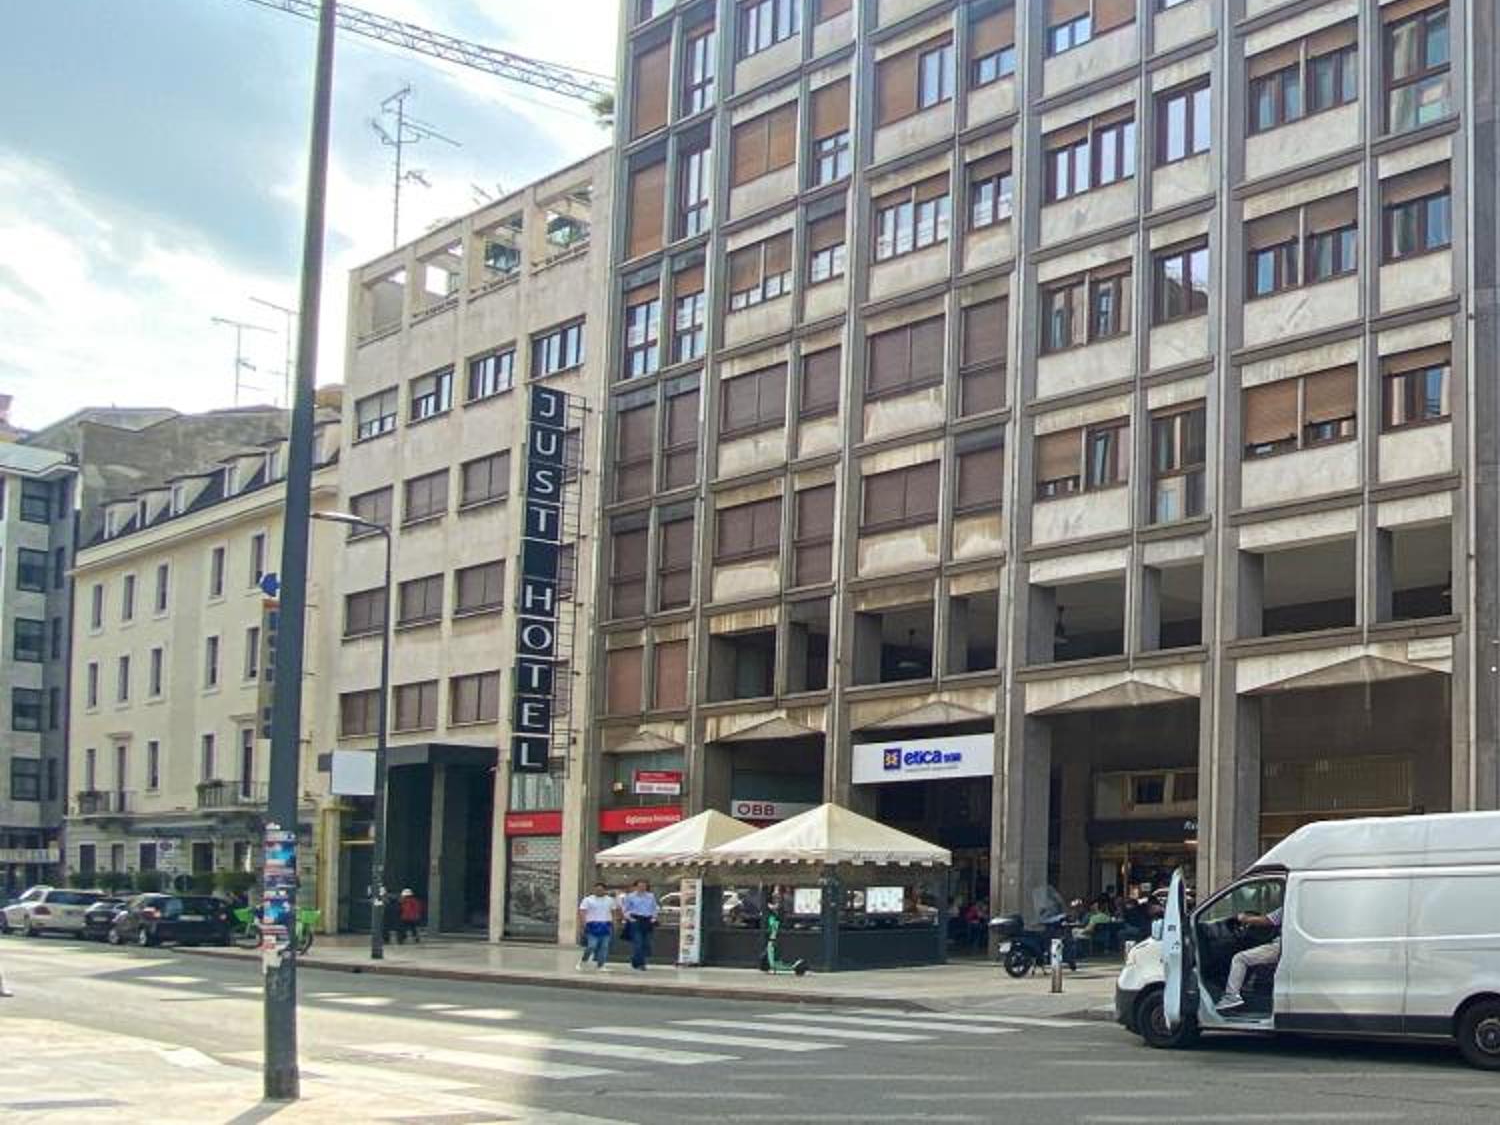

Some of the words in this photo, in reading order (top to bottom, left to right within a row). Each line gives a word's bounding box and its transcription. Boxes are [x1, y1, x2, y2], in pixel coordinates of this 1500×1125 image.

[529, 393, 556, 532] JUST
[520, 584, 552, 766] HOTEL
[903, 750, 942, 765] etica
